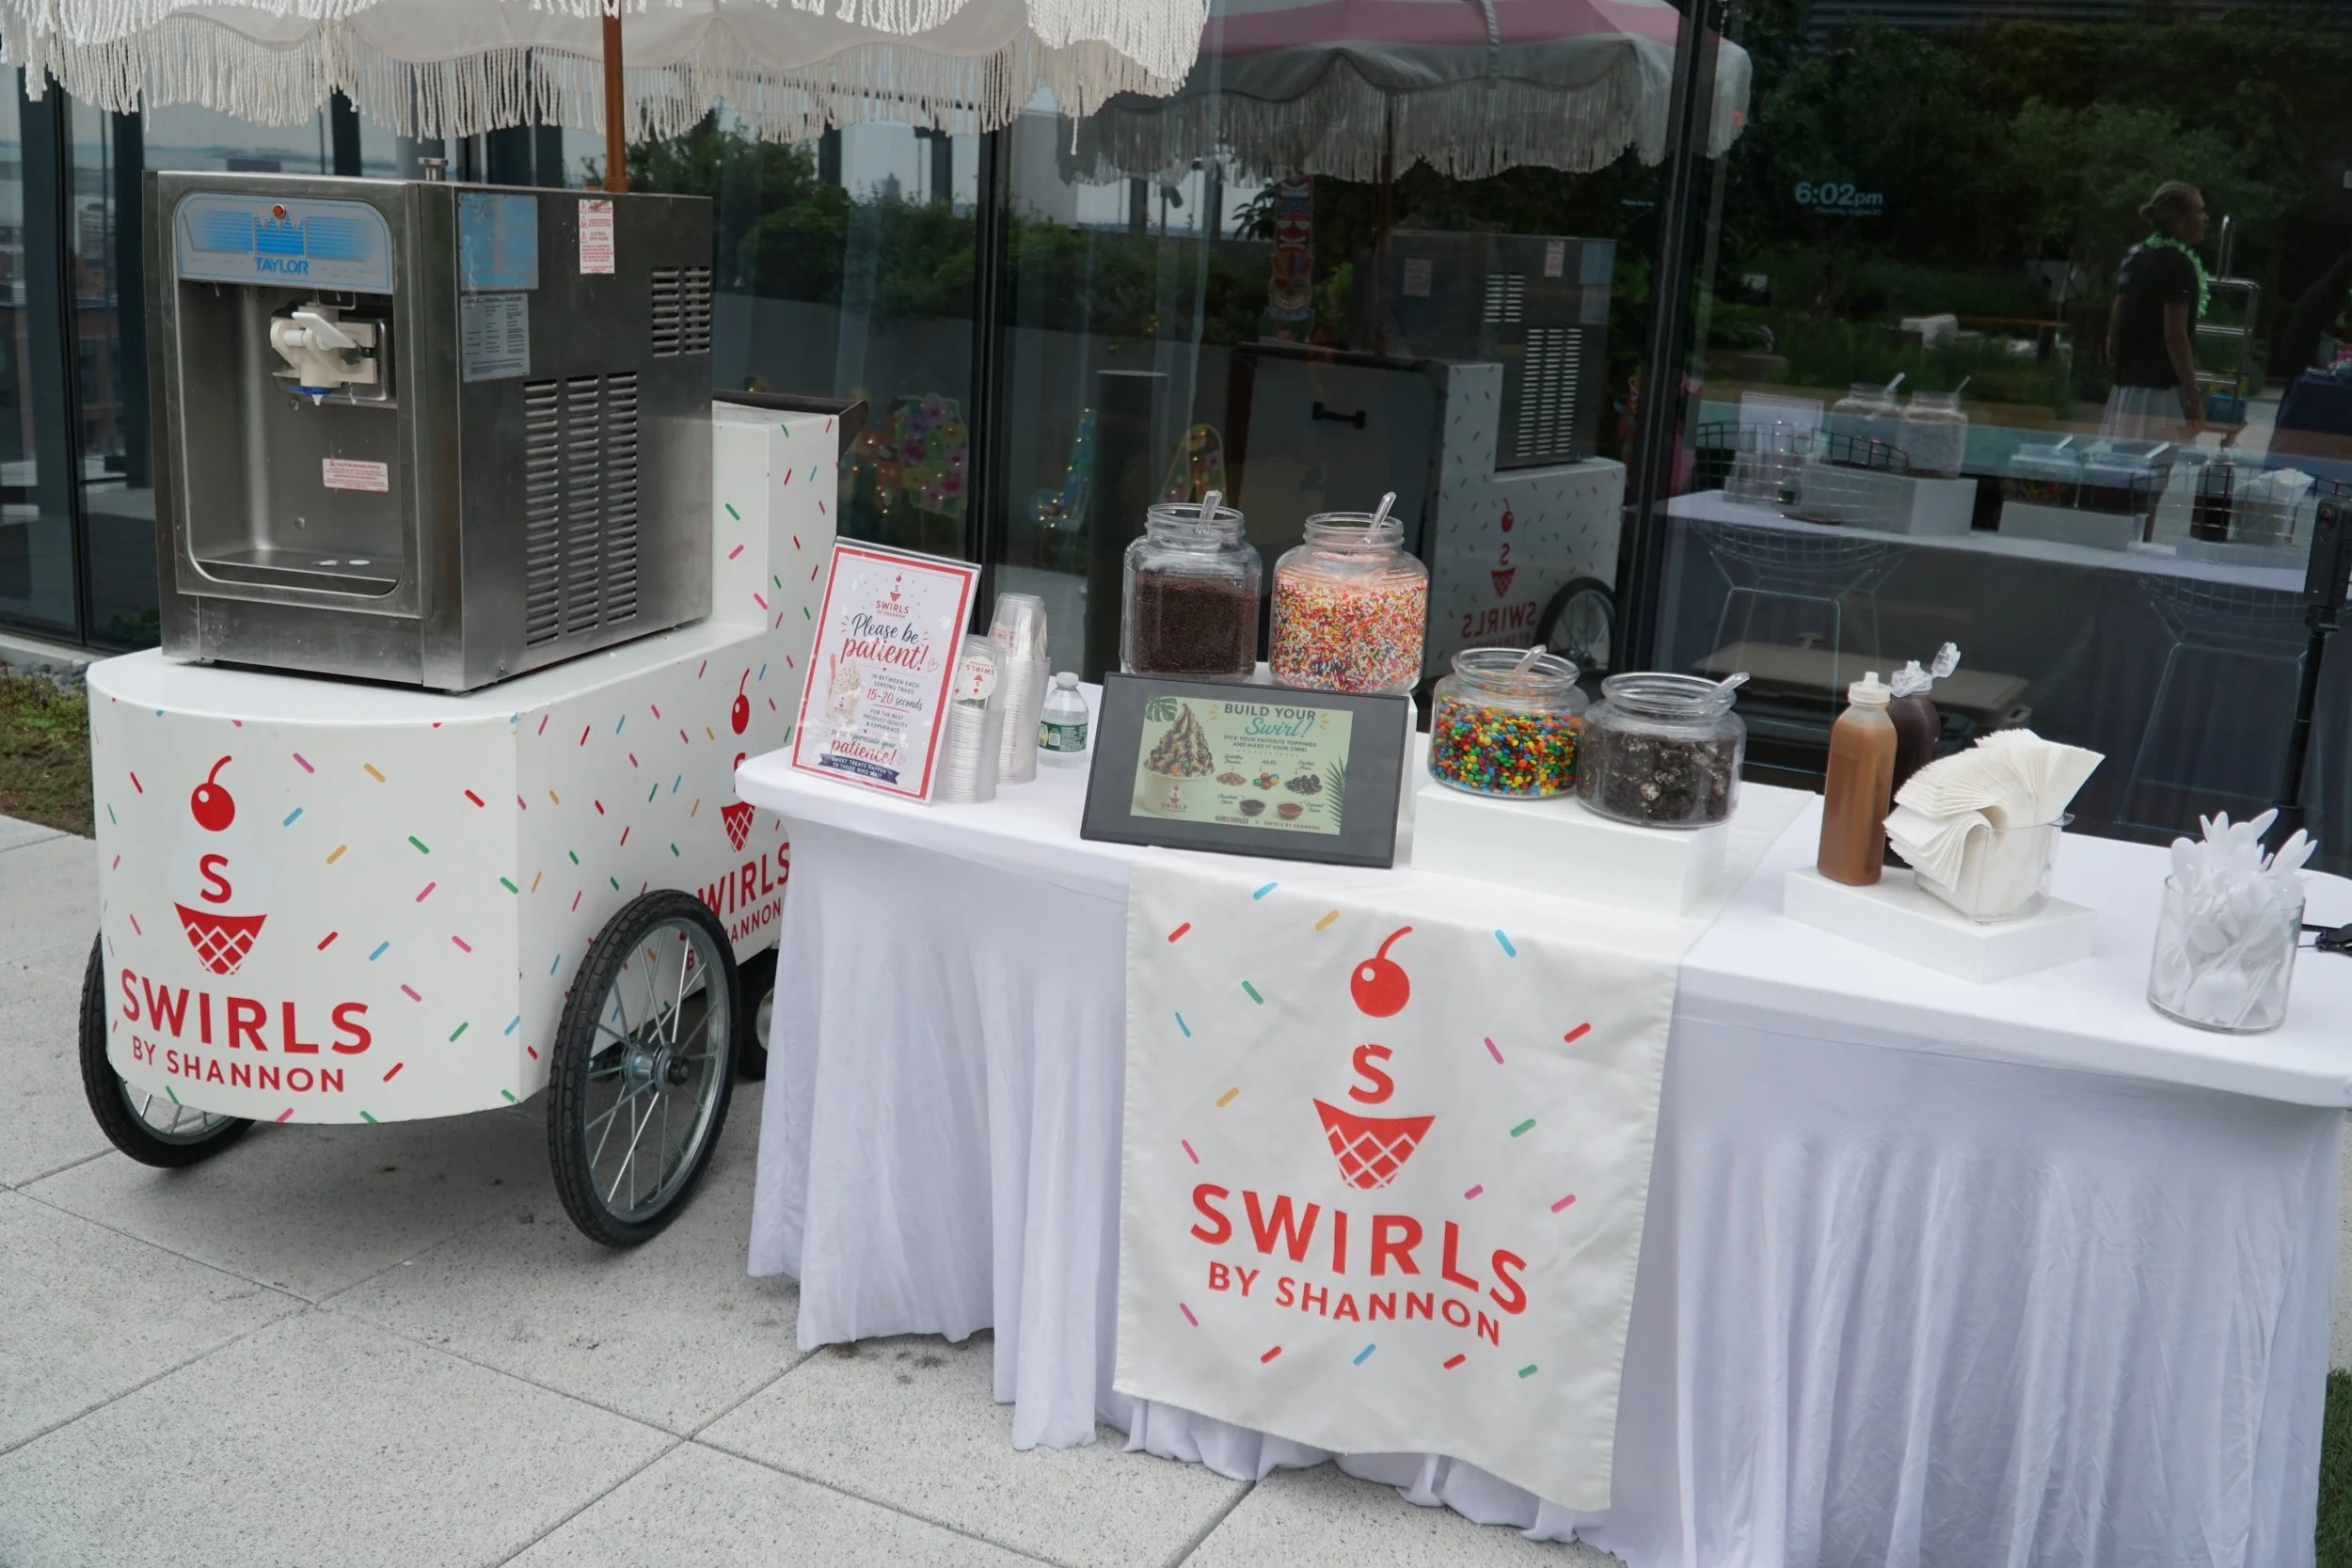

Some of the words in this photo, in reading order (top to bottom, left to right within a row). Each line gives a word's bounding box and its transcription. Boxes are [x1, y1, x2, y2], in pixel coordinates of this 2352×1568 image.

[1795, 182, 1883, 207] 6:02pm
[254, 256, 310, 275] TAYLOR
[876, 600, 910, 614] SWIRLS
[851, 612, 898, 639] Please
[901, 622, 919, 644] be
[840, 636, 930, 671] patient!
[874, 681, 896, 690] SERVING
[898, 686, 914, 694] TAKES
[879, 674, 904, 685] BETWEEN
[905, 680, 920, 689] EACH
[866, 688, 894, 705] 15-20
[895, 697, 923, 712] seconds
[863, 713, 886, 723] PRODUCT
[887, 719, 908, 728] QUALITY
[1224, 704, 1269, 717] BUILD
[1275, 707, 1316, 721] YOUR
[870, 722, 900, 734] EXPERIENCE
[1244, 717, 1314, 738] Swirl!
[829, 739, 898, 765] patience!
[881, 741, 896, 750] your
[1287, 739, 1317, 748] TOPPINGS
[839, 763, 856, 771] THOSE
[856, 767, 869, 775] WHO
[869, 770, 882, 779] WAIT
[849, 758, 866, 768] TREATS
[867, 764, 887, 774] HAPPEN
[1161, 801, 1188, 810] SWIRLS
[199, 853, 232, 903] S
[697, 842, 790, 919] WIRLS
[725, 897, 781, 945] ANNON
[120, 968, 372, 1055] SWIRLS
[133, 1035, 155, 1066] BY
[167, 1049, 344, 1093] SHANNON
[1348, 1044, 1394, 1104] S
[1190, 1183, 1527, 1315] SWIRLS
[1208, 1261, 1261, 1297] BY
[1276, 1276, 1500, 1347] SHANNON
